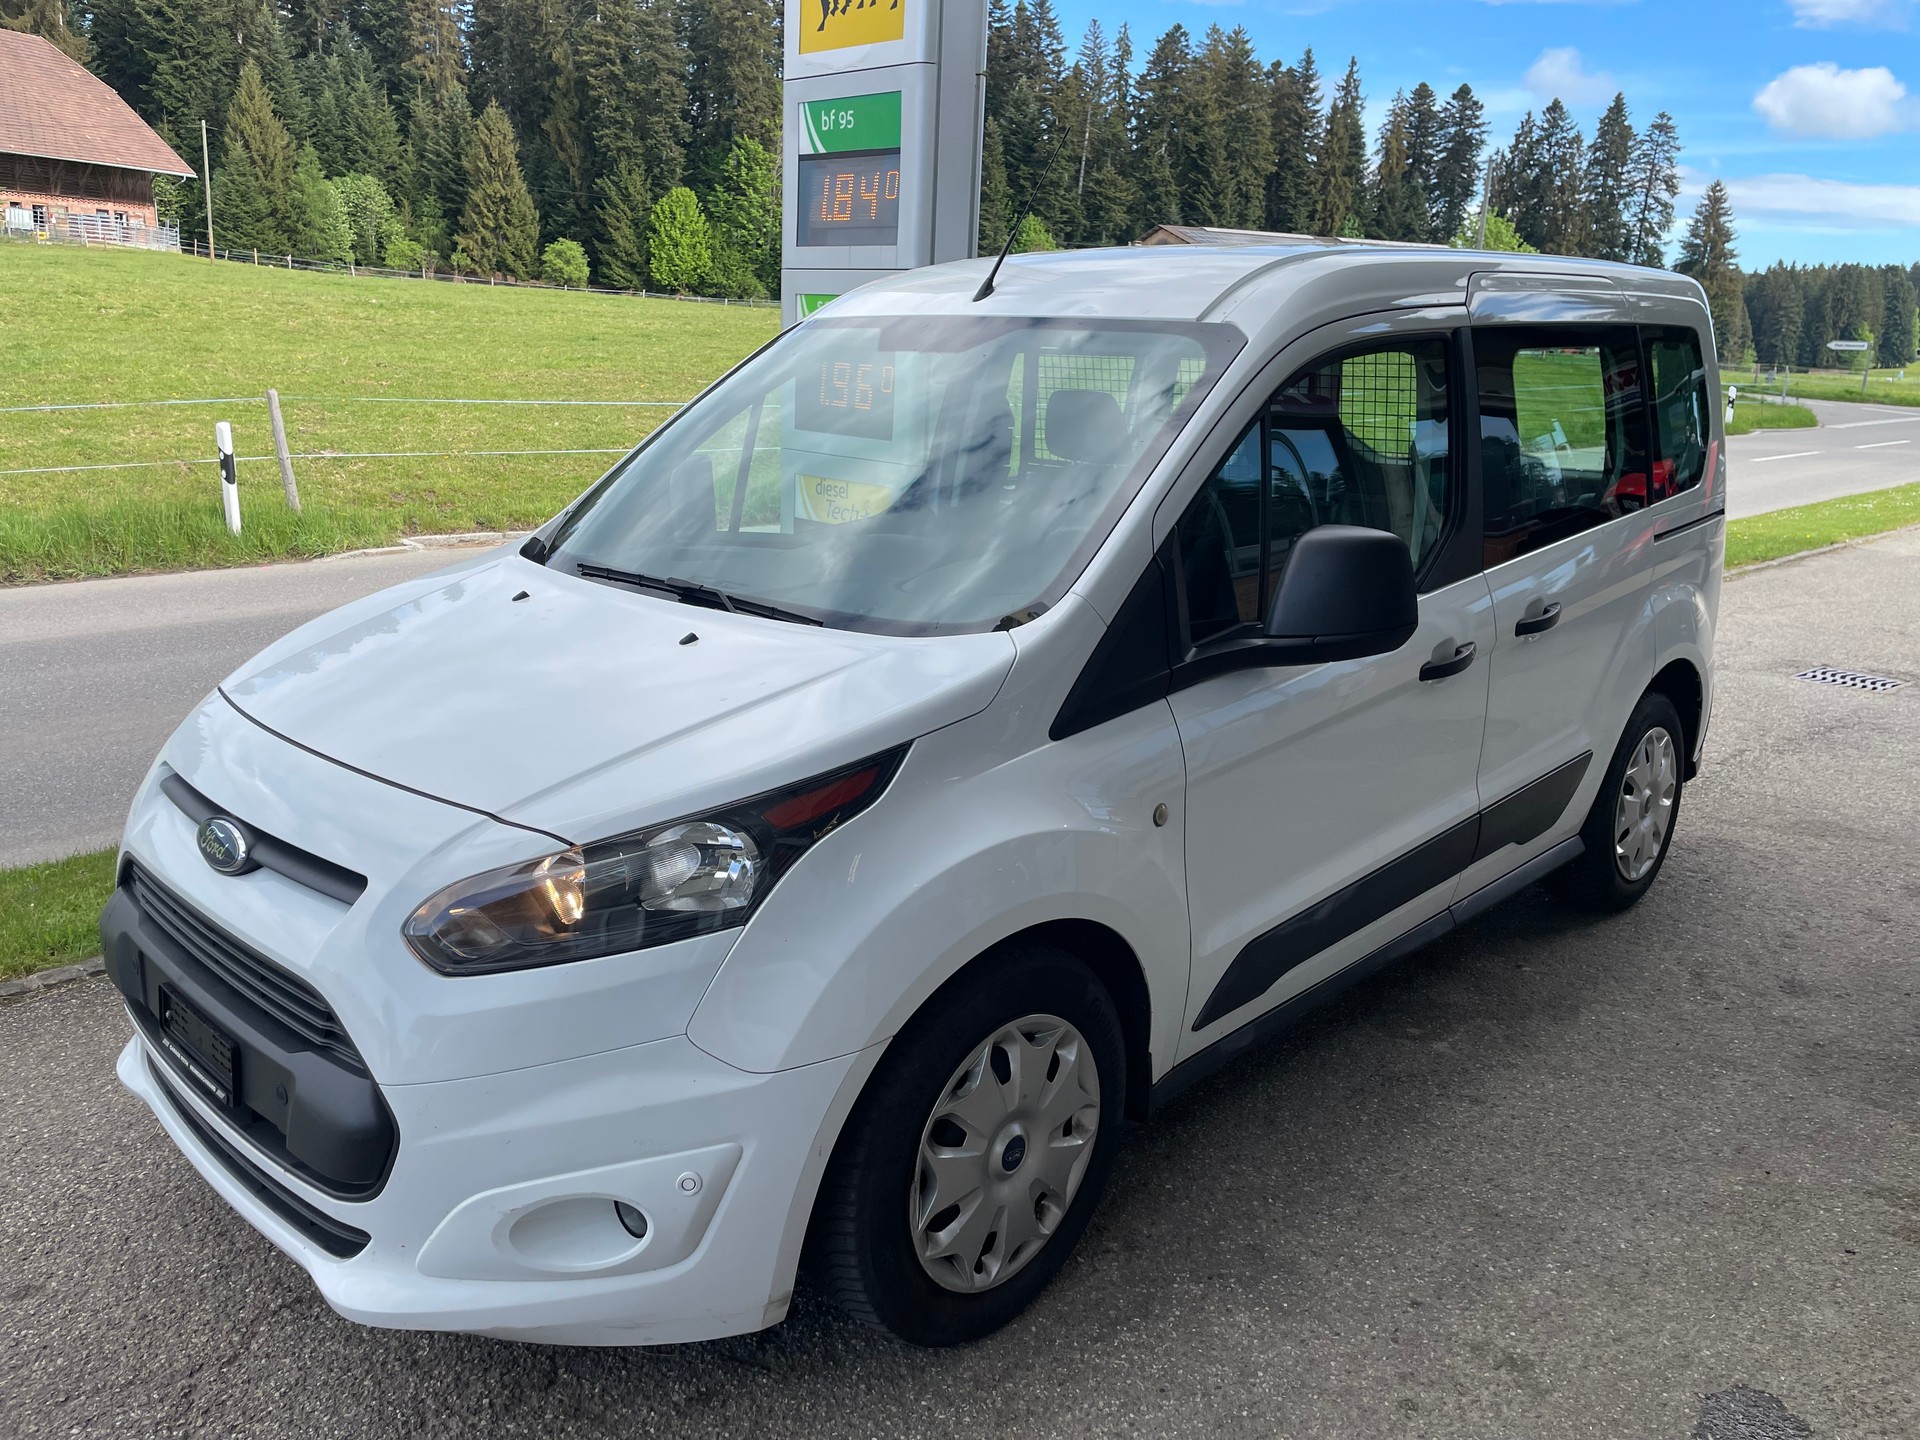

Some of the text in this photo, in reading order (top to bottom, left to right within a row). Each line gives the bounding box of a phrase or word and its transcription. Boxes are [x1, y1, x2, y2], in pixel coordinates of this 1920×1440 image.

[821, 109, 855, 131] bf 95
[815, 478, 849, 500] diesel
[202, 826, 228, 858] Ford
